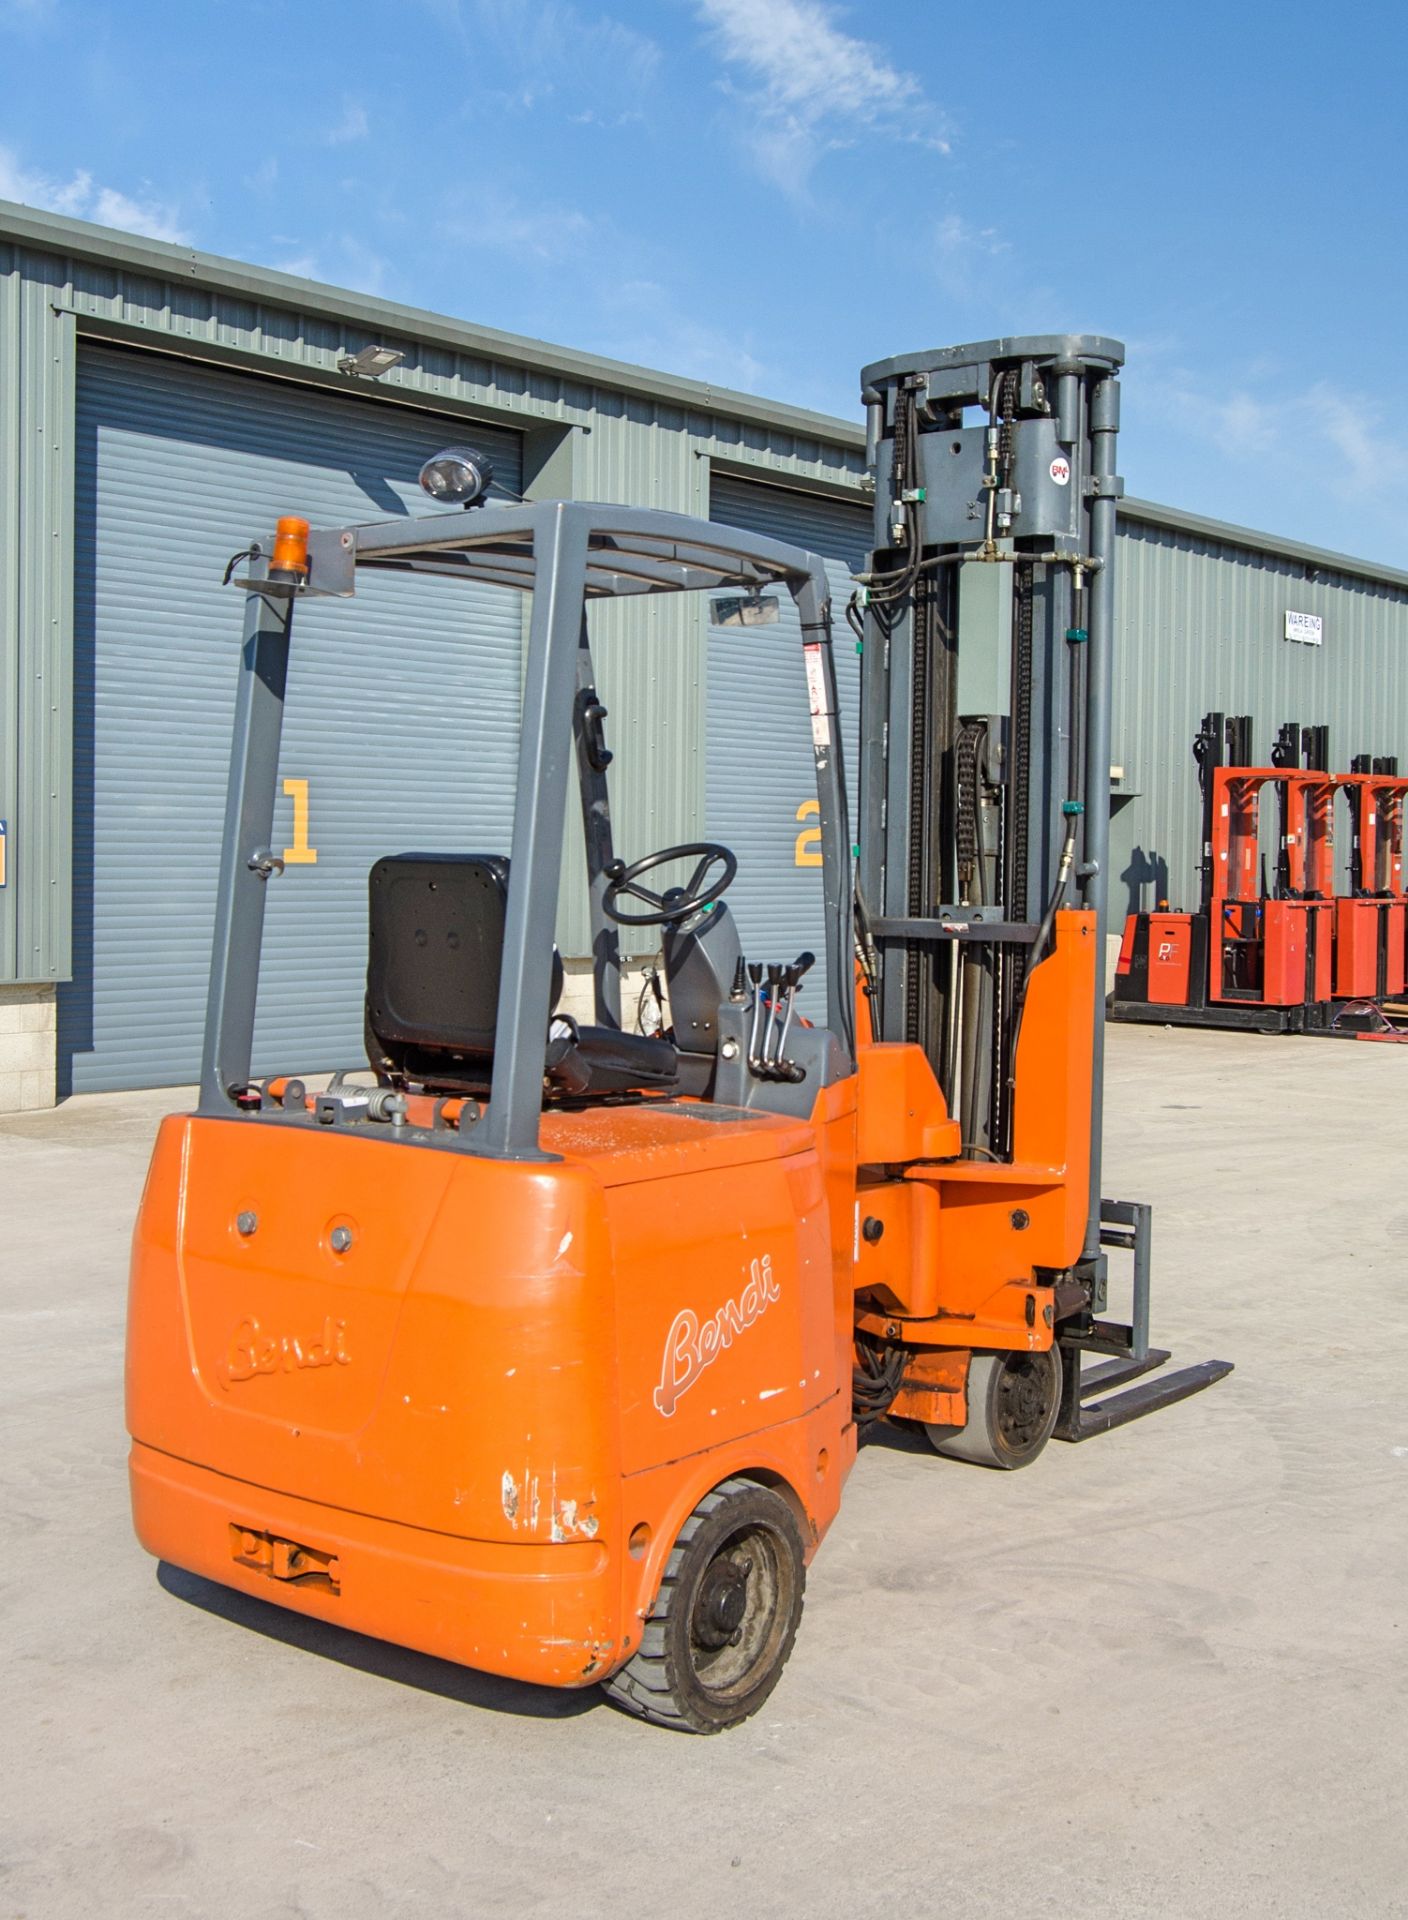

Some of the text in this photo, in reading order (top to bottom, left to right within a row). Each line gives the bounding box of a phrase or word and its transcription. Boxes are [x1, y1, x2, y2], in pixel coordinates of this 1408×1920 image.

[1287, 611, 1321, 630] WAREING
[283, 779, 317, 863] 1
[218, 1313, 352, 1391] Bendi
[654, 1254, 780, 1417] Bendi
